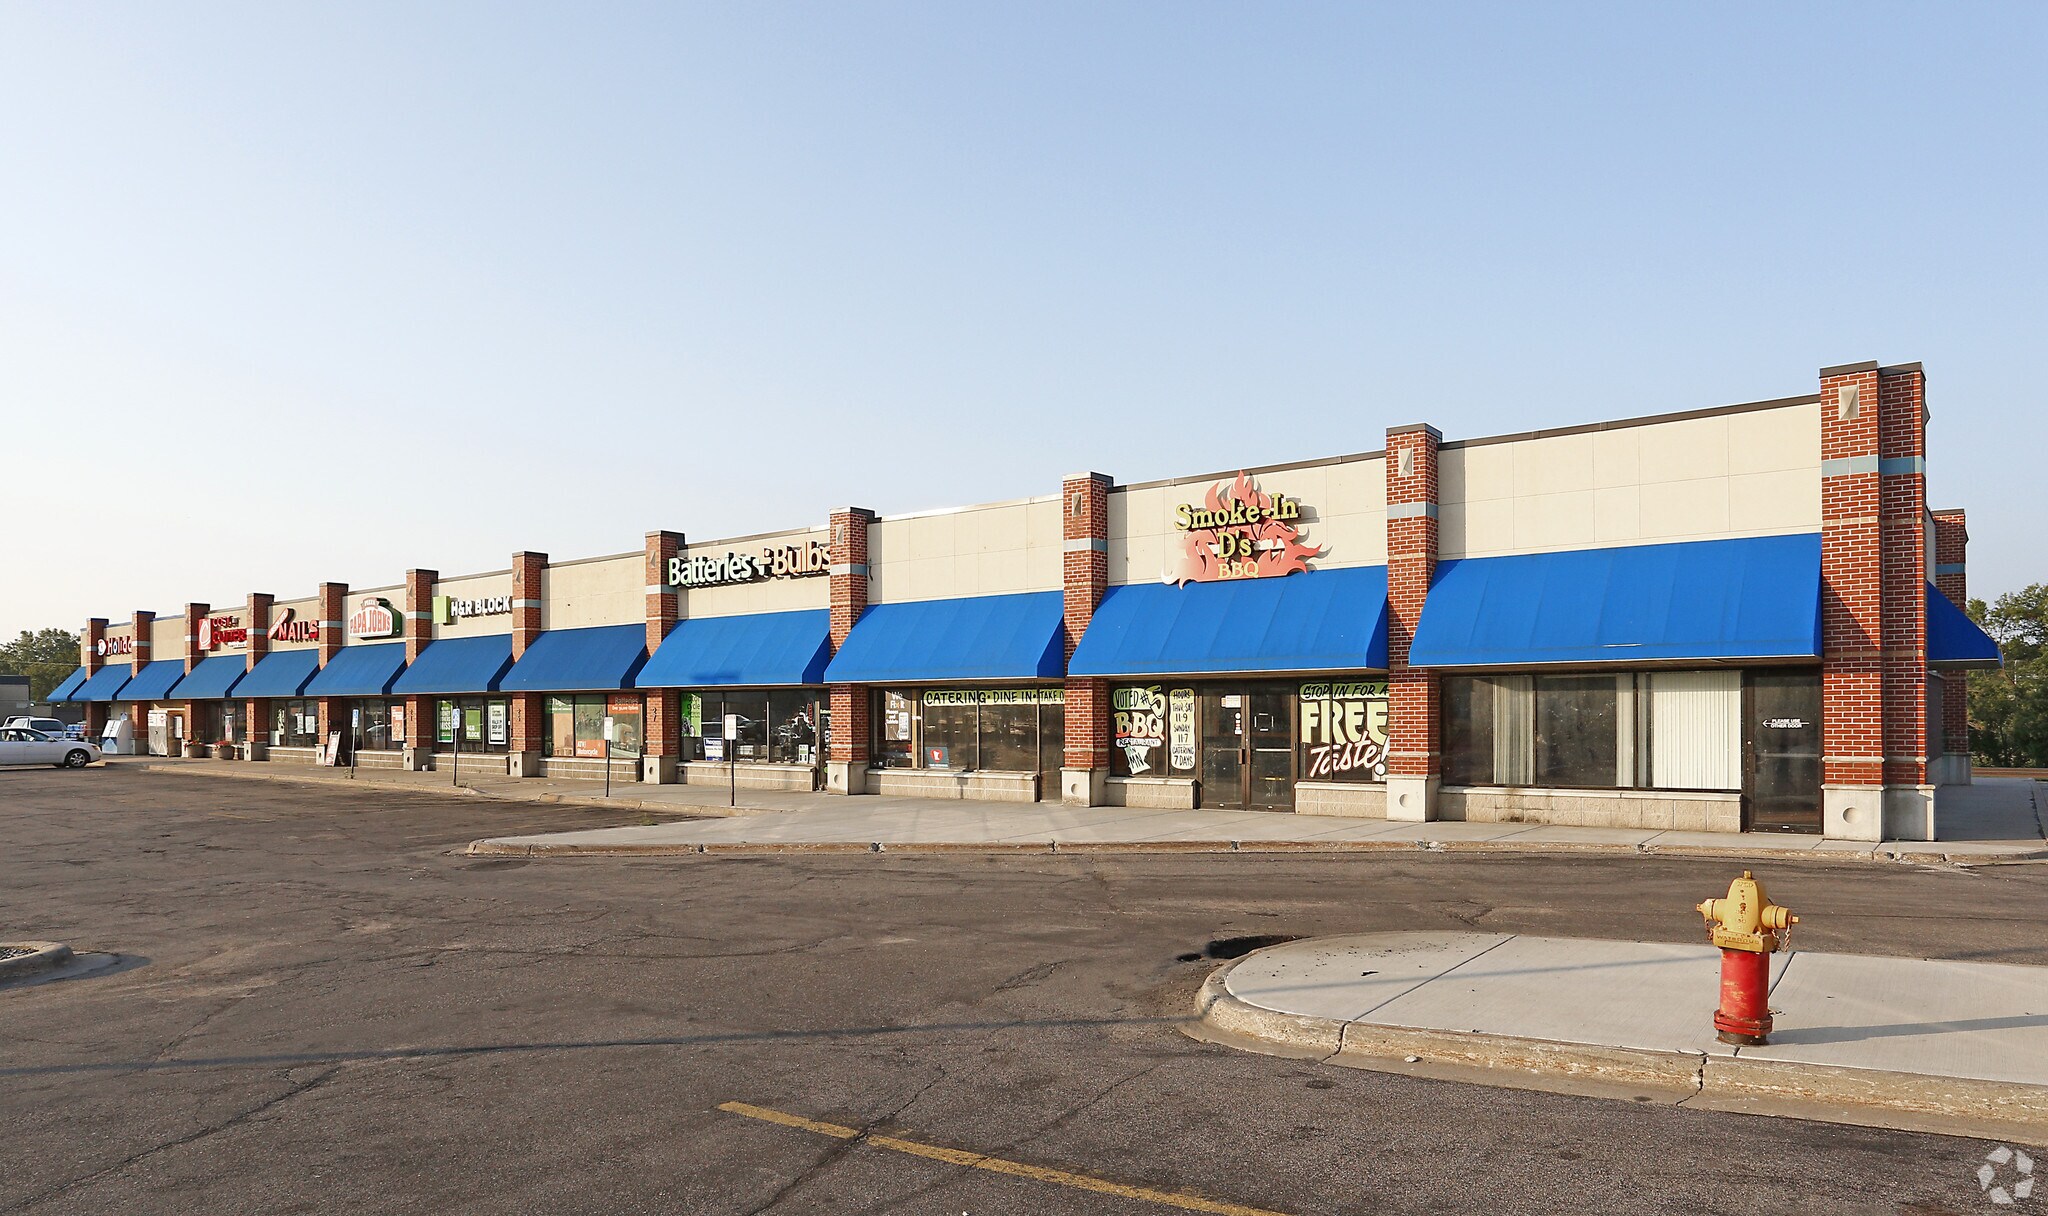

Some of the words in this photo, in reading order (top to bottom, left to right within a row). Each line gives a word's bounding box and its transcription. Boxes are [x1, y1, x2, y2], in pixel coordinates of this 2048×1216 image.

[1174, 493, 1298, 531] Smoke-In
[1217, 529, 1252, 558] D's
[669, 553, 753, 586] Batteries
[774, 542, 830, 575] Bulbs
[1218, 561, 1259, 578] BBQ
[451, 600, 473, 617] H&R
[475, 596, 511, 614] BLOCK
[278, 620, 318, 641] NAILS
[349, 611, 367, 634] PAPA
[926, 689, 987, 705] CATERING
[993, 690, 1018, 703] DINE
[1021, 690, 1032, 702] IN
[1040, 690, 1057, 702] TAKE
[1115, 690, 1139, 709] VOTED
[1303, 684, 1331, 699] STOP
[1333, 684, 1350, 698] IN
[1351, 684, 1376, 697] FOR
[1114, 711, 1165, 741] BBQ
[1300, 699, 1389, 746] FREE
[1171, 746, 1195, 755] CATERING
[1173, 754, 1179, 766] 7
[1179, 754, 1194, 767] DAYS
